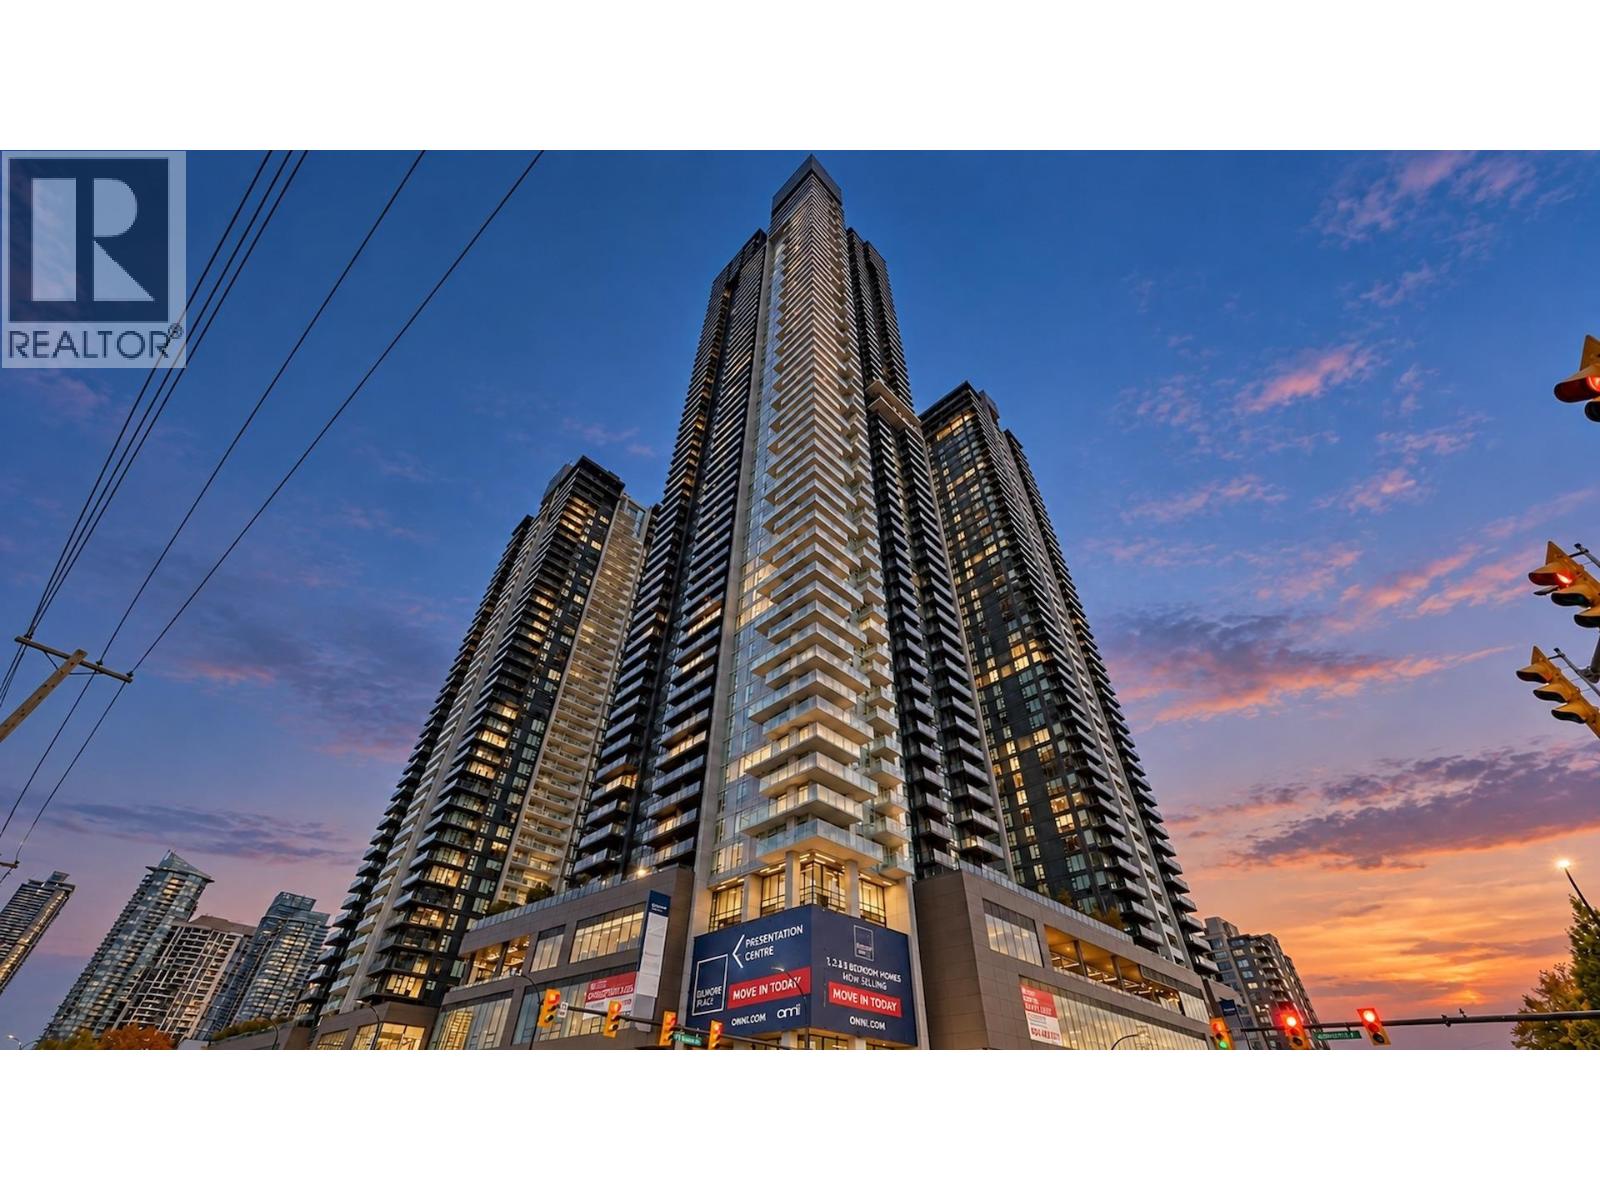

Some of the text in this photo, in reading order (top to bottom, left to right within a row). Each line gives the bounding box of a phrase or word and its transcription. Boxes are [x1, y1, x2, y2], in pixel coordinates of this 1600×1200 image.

[745, 925, 804, 948] PRESENTATION
[744, 946, 774, 962] CENTRE
[842, 972, 887, 991] NOW SELLING
[879, 970, 902, 983] HOMES
[696, 985, 722, 998] GILMORE
[732, 977, 802, 1000] MOVE IN TODAY
[832, 988, 897, 1012] MOVE IN TODAY
[731, 1013, 767, 1026] ONNI.COM
[849, 1015, 887, 1031] ONNI.COM
